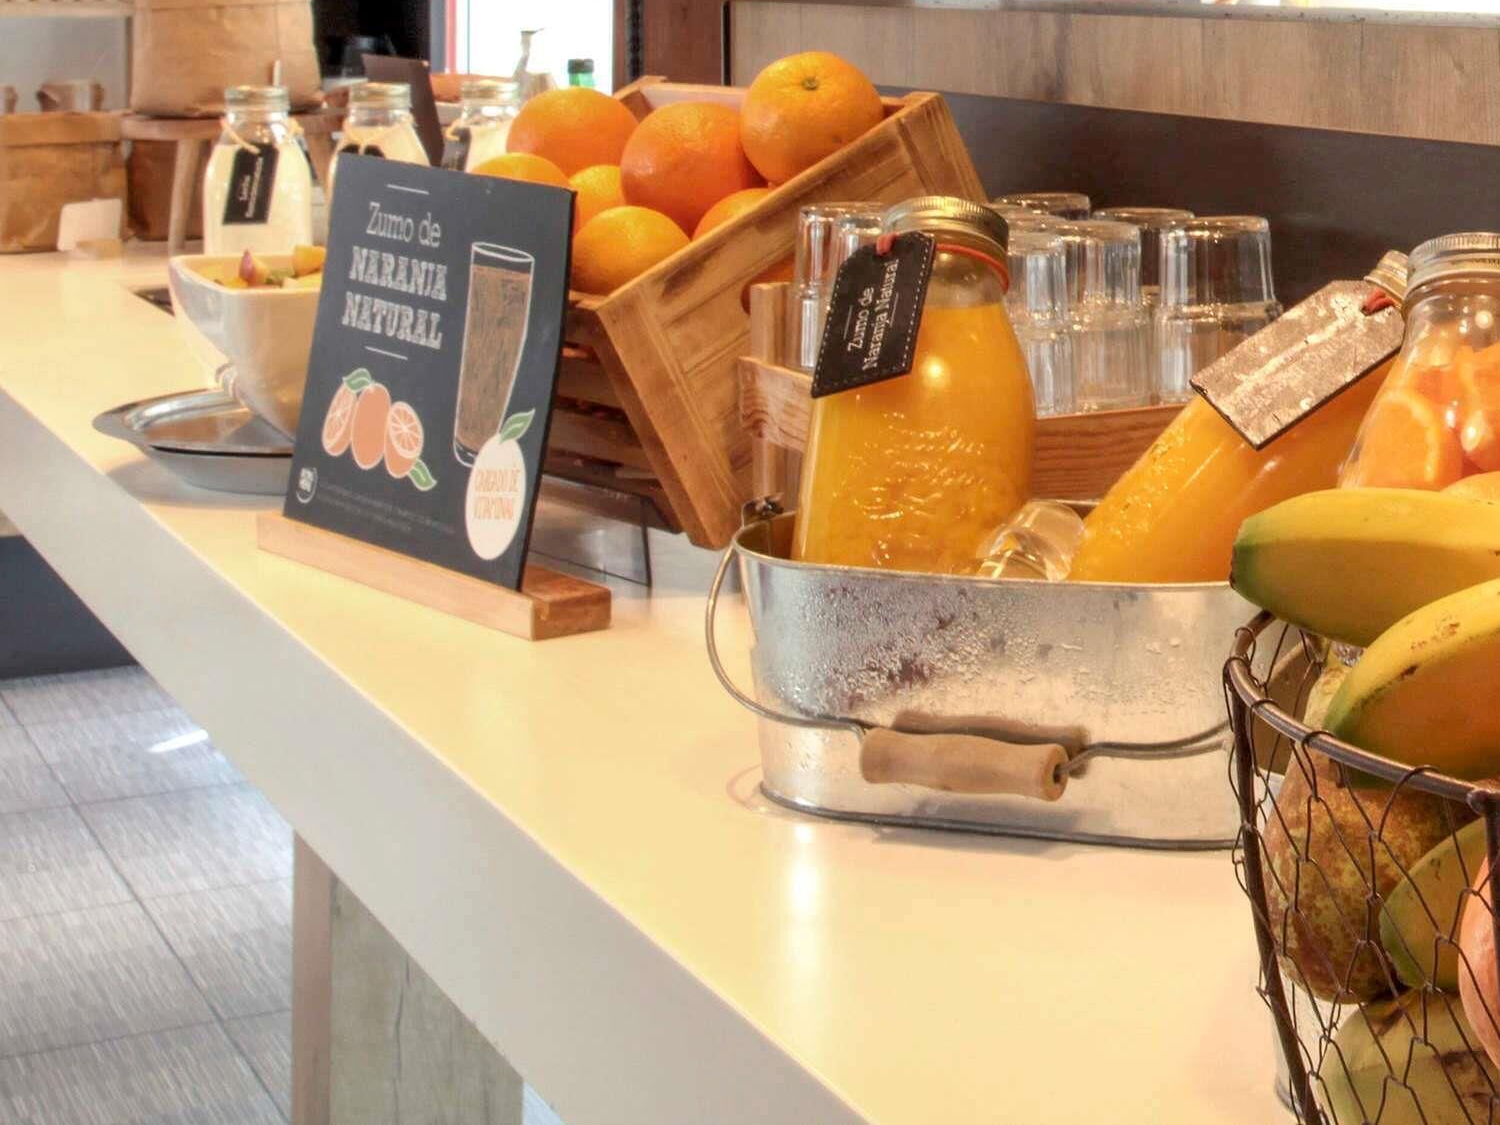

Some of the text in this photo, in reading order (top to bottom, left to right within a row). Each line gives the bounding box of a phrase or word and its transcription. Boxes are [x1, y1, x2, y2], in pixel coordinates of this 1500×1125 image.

[365, 201, 442, 248] Zumo de
[348, 245, 448, 301] NARANJA
[341, 291, 443, 350] NATURAL
[847, 285, 875, 352] Zumo de
